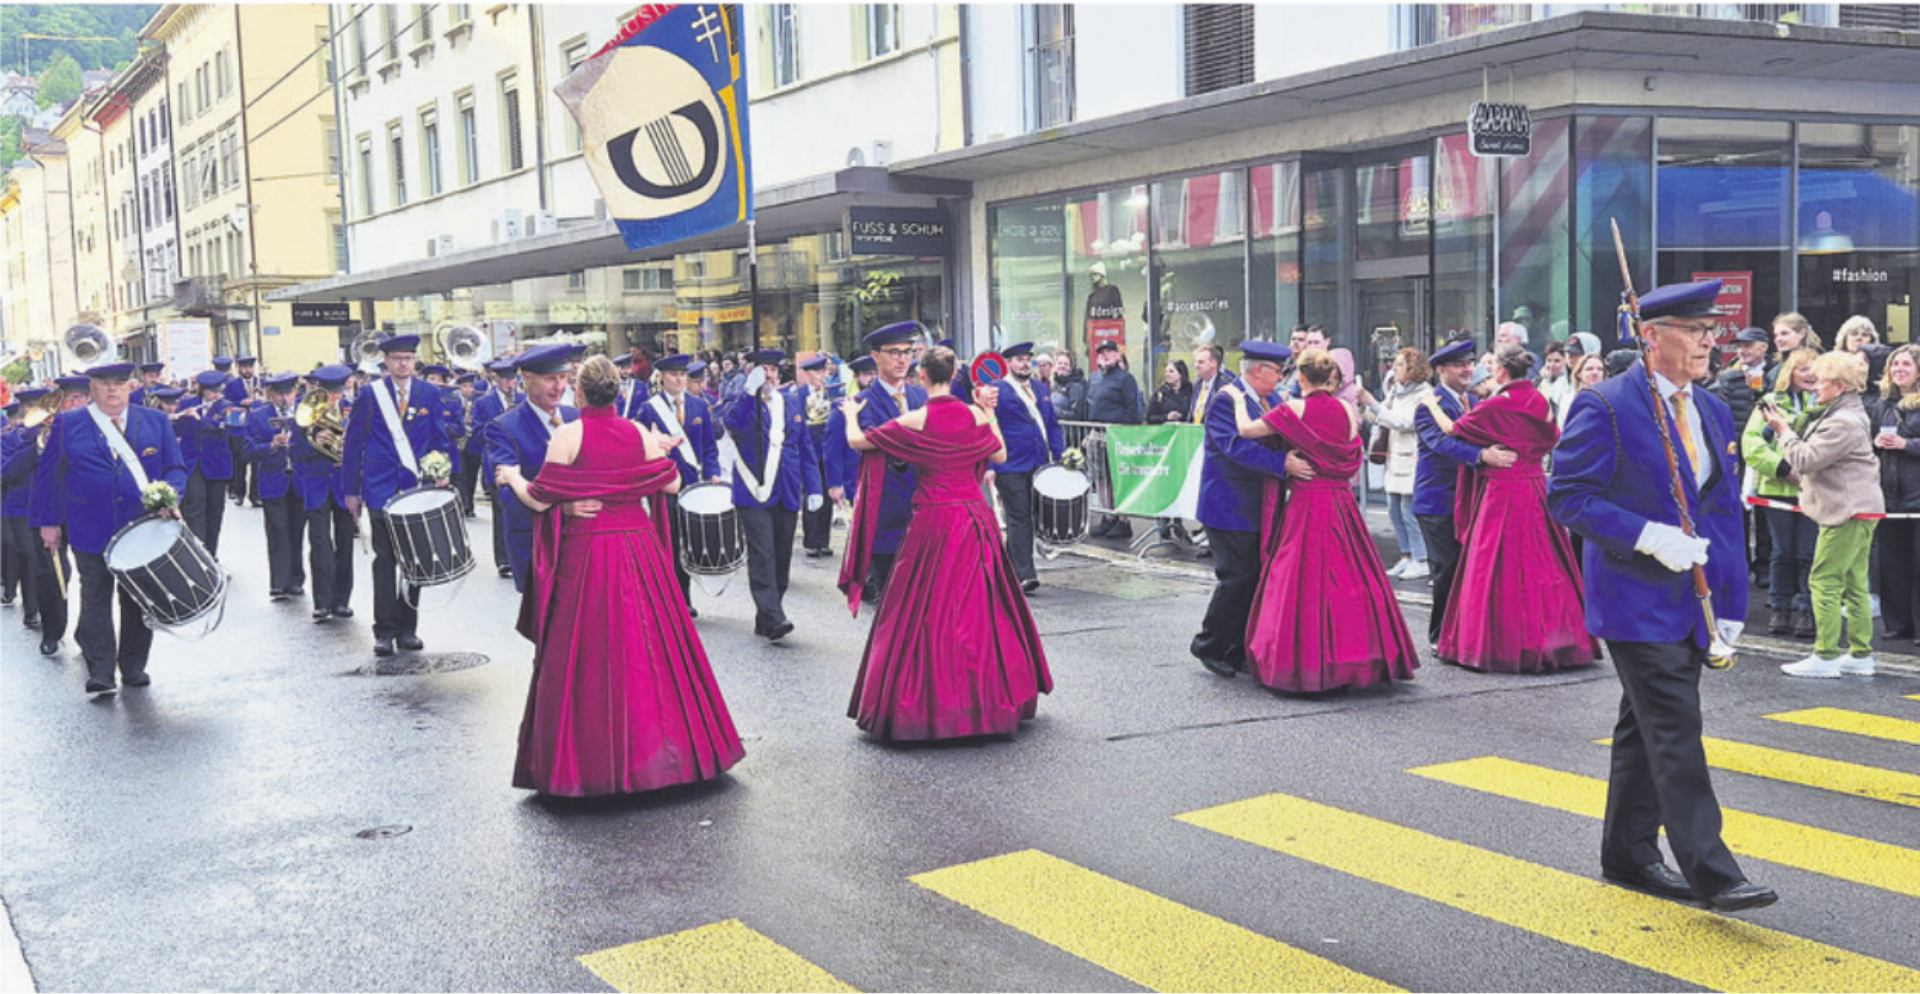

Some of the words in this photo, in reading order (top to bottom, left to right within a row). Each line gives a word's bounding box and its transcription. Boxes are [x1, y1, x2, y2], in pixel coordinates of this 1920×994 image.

[853, 221, 885, 235] FUSS
[888, 222, 898, 235] &
[901, 222, 945, 236] SCHUH
[1832, 267, 1888, 282] #fashion
[1090, 305, 1125, 319] #design
[1167, 297, 1229, 312] #accessories
